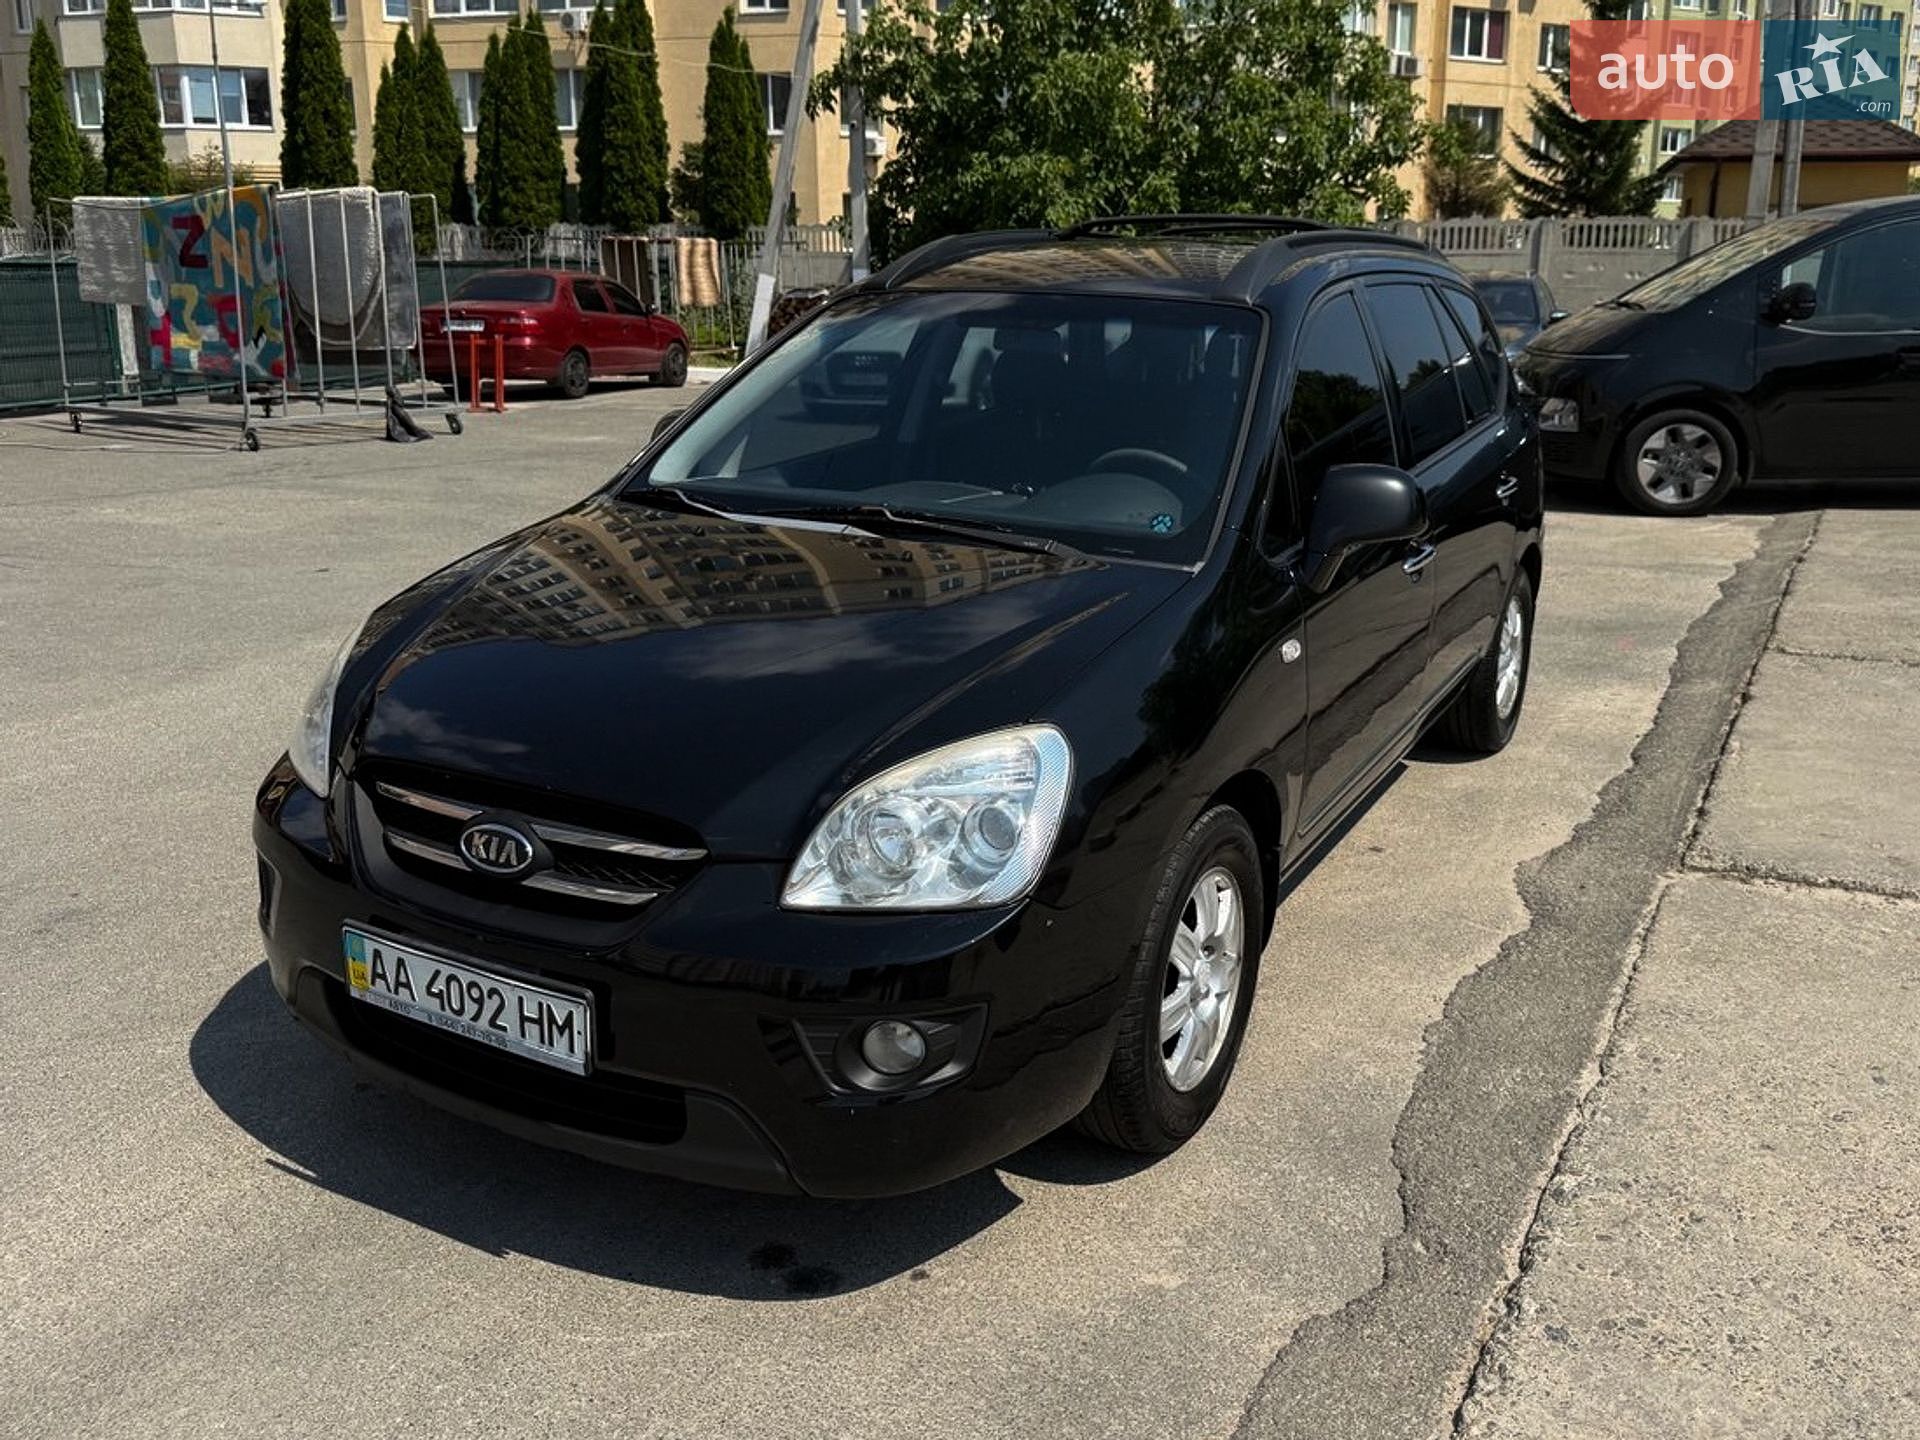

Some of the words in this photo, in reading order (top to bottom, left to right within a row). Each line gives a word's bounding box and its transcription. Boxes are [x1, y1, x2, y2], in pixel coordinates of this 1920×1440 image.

[471, 831, 518, 866] KIA
[370, 948, 417, 1002] AA
[426, 968, 508, 1033] 4092
[518, 995, 575, 1054] HM
